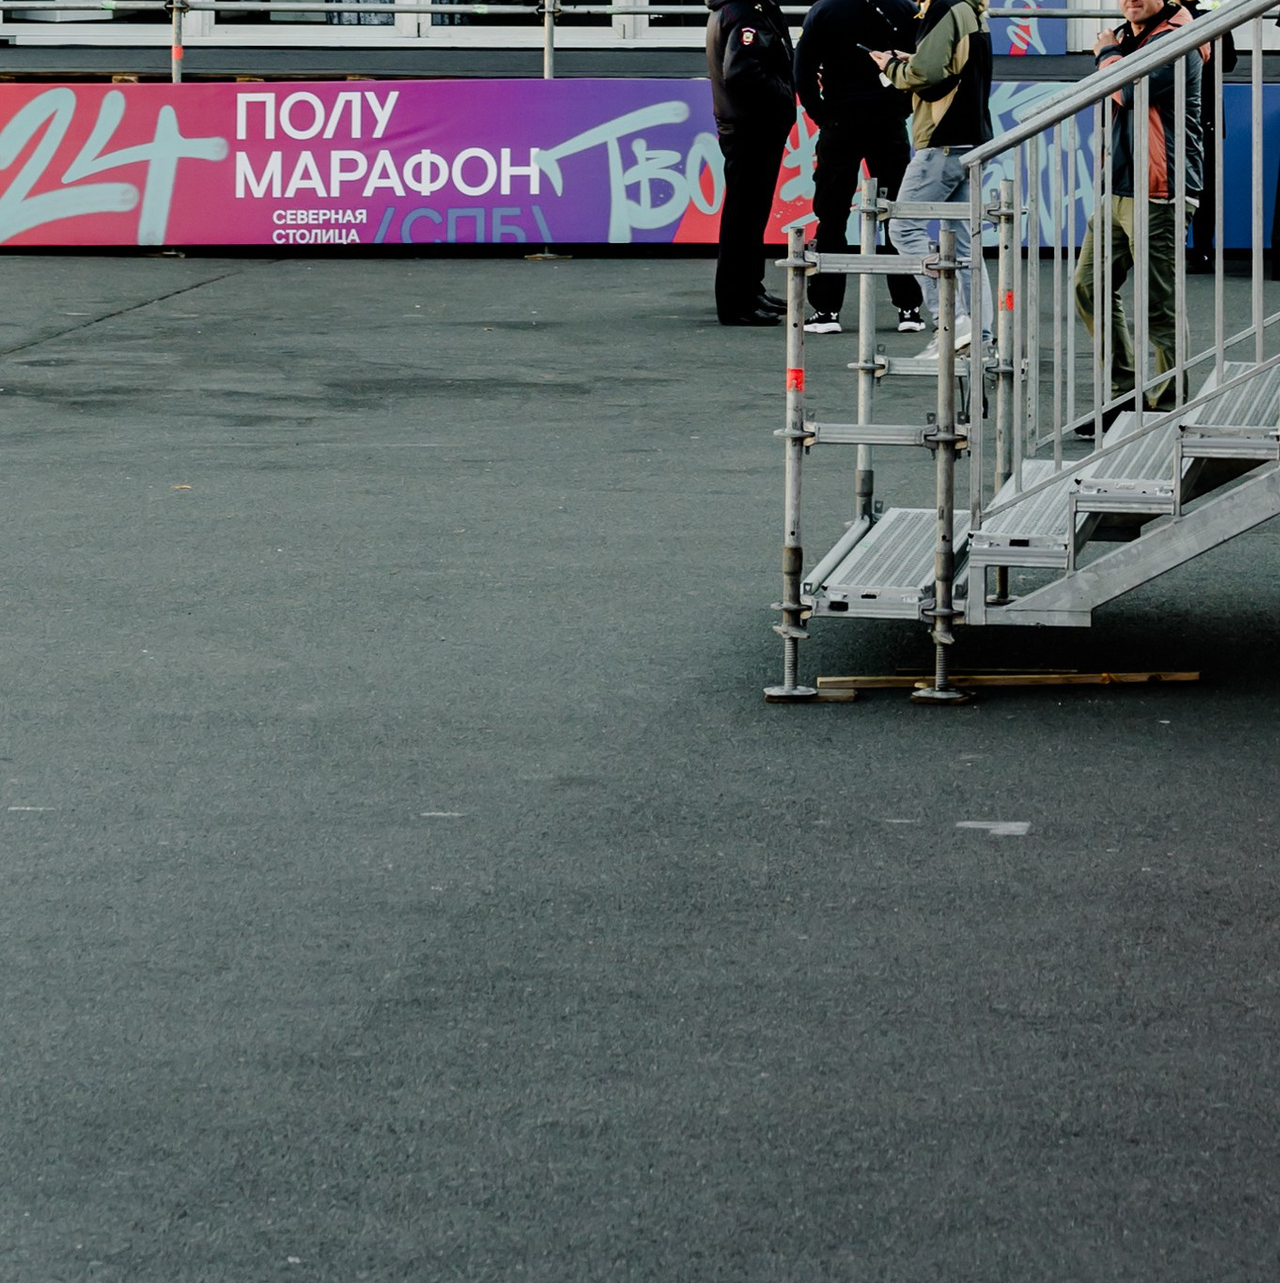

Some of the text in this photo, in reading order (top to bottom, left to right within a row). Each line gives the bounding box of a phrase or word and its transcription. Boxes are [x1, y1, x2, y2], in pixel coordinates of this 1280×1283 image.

[236, 91, 399, 140] ПОЛУ
[235, 147, 540, 198] МАРАФОН
[272, 209, 367, 225] СЕВЕРНАЯ
[272, 228, 360, 244] СТОЛИЦА
